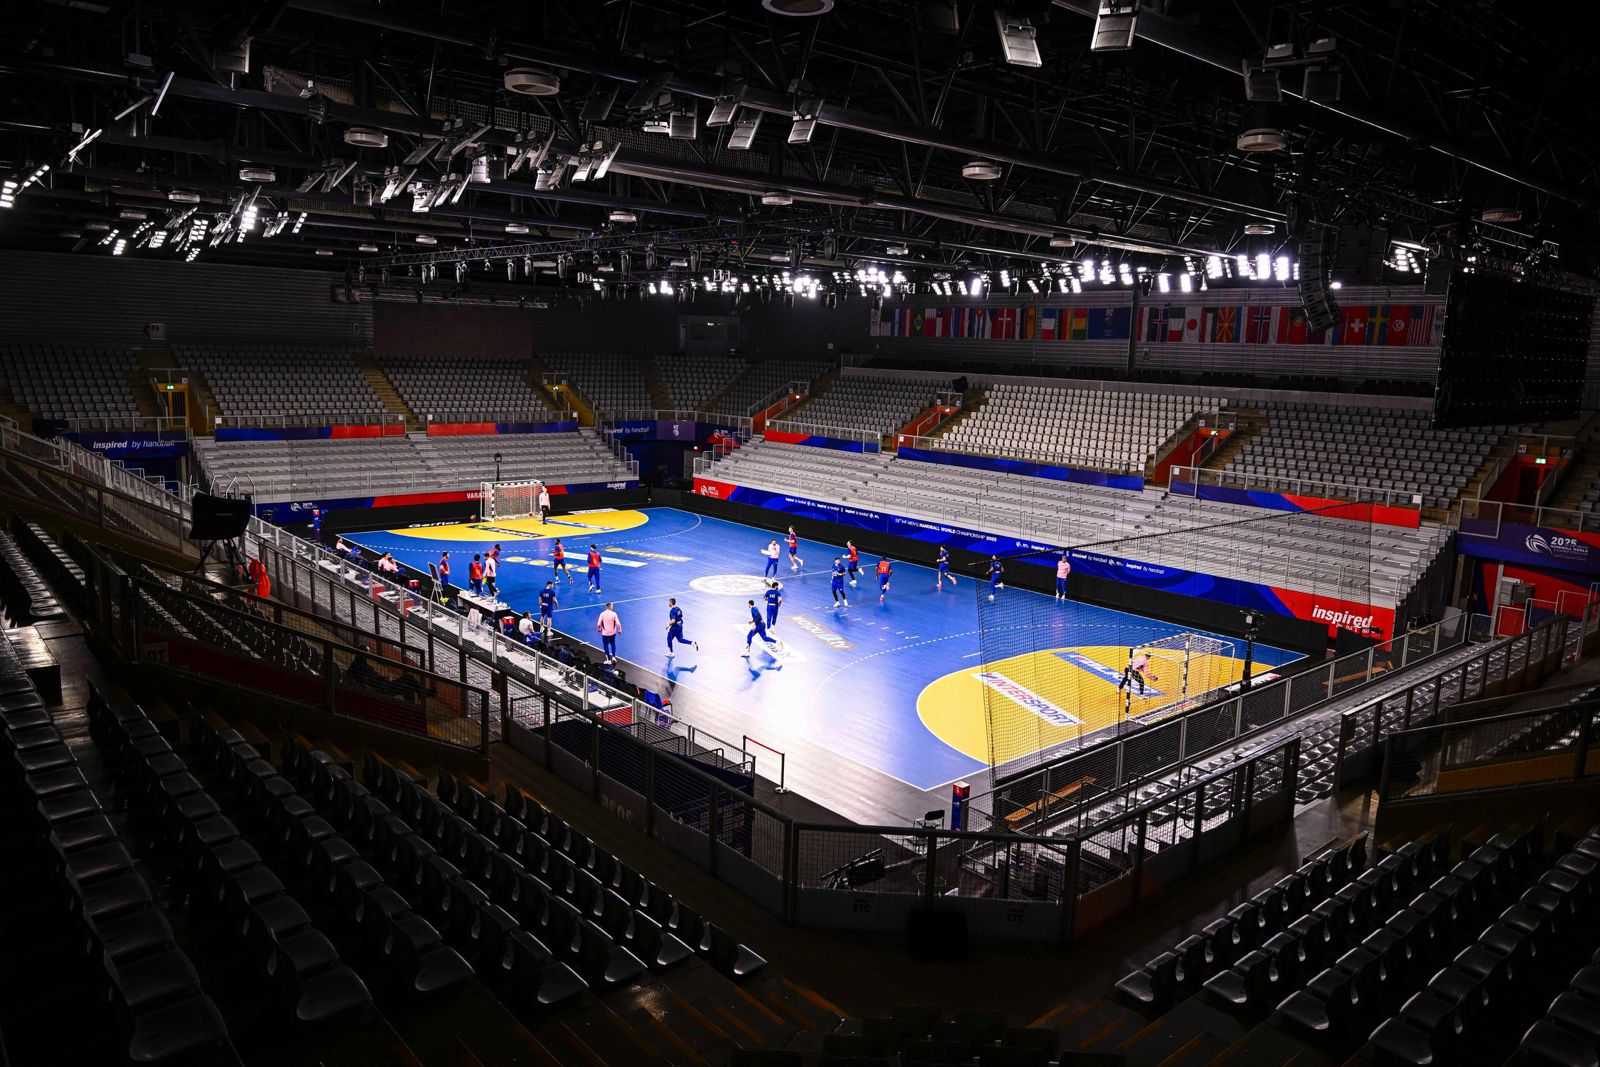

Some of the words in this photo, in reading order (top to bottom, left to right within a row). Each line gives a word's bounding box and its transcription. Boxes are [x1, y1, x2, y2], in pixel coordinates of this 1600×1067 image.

[93, 441, 128, 450] inspired
[132, 441, 142, 450] by
[143, 440, 176, 448] handball
[919, 523, 941, 532] HANDBALL
[1550, 536, 1578, 546] 2025
[1312, 604, 1374, 628] inspired
[990, 675, 1077, 725] INTERSPORT
